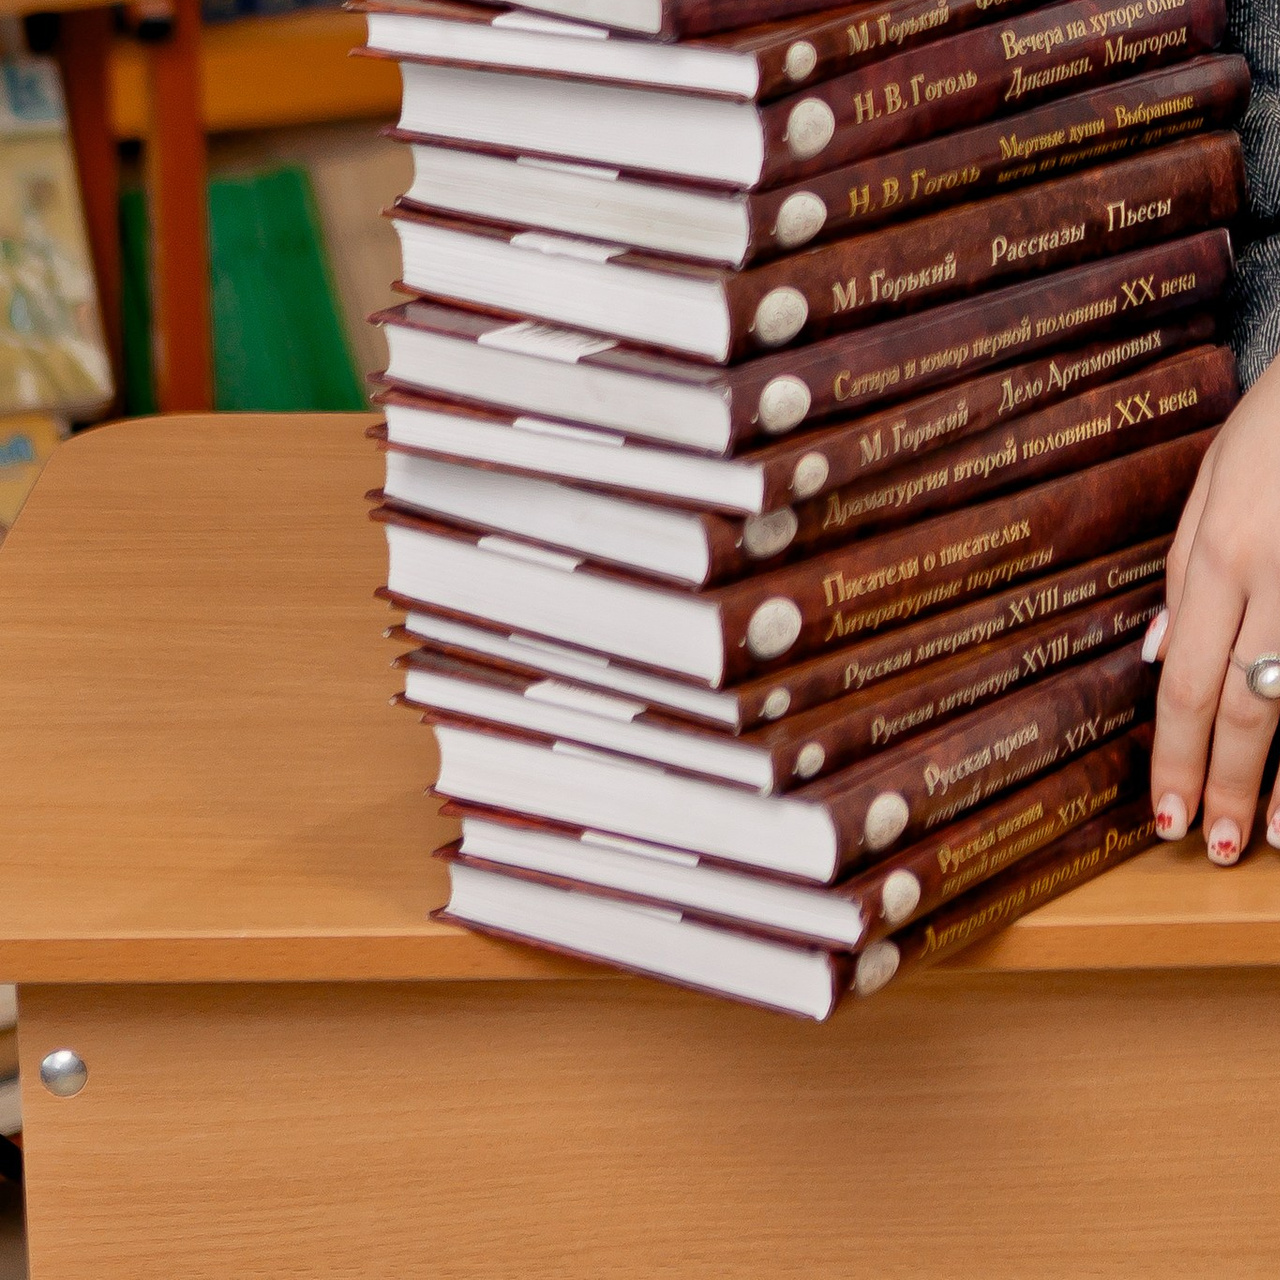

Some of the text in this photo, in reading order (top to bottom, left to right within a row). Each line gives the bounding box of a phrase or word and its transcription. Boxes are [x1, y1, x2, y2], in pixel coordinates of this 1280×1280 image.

[846, 20, 876, 56] М.
[1001, 28, 1064, 61] Вечера
[1066, 18, 1088, 41] на
[1088, 1, 1145, 37] хуторе
[1004, 26, 1188, 102] Диканьки. Миргород
[853, 70, 979, 124] Н. В. Гоголь
[999, 94, 1195, 162] Мертвые души Выбранные
[849, 167, 982, 218] Н. В. Гоголь
[832, 197, 1173, 315] М. Горький Рассказы Пьесы
[833, 271, 1197, 403] Сатира и юмор первой половины XX века
[859, 328, 1163, 468] М. Горький Дело Артамоновых
[822, 386, 1199, 531] Драматургия второй половины XX века
[822, 517, 1032, 608] Писатели о писателях
[825, 544, 1055, 643] Литературные портреты
[843, 648, 913, 691] Русская
[913, 614, 1006, 664] литература
[1007, 584, 1060, 629] XVIII
[1062, 579, 1098, 607] века
[870, 702, 935, 746] Русская
[936, 665, 1021, 717] литература
[1022, 631, 1070, 678] XVIII
[1071, 628, 1104, 656] века
[924, 718, 1041, 798] Русская проза
[1061, 713, 1102, 758] XIX
[1057, 792, 1092, 830] XIX
[918, 888, 1027, 961] Литература
[1028, 847, 1102, 901] народов
